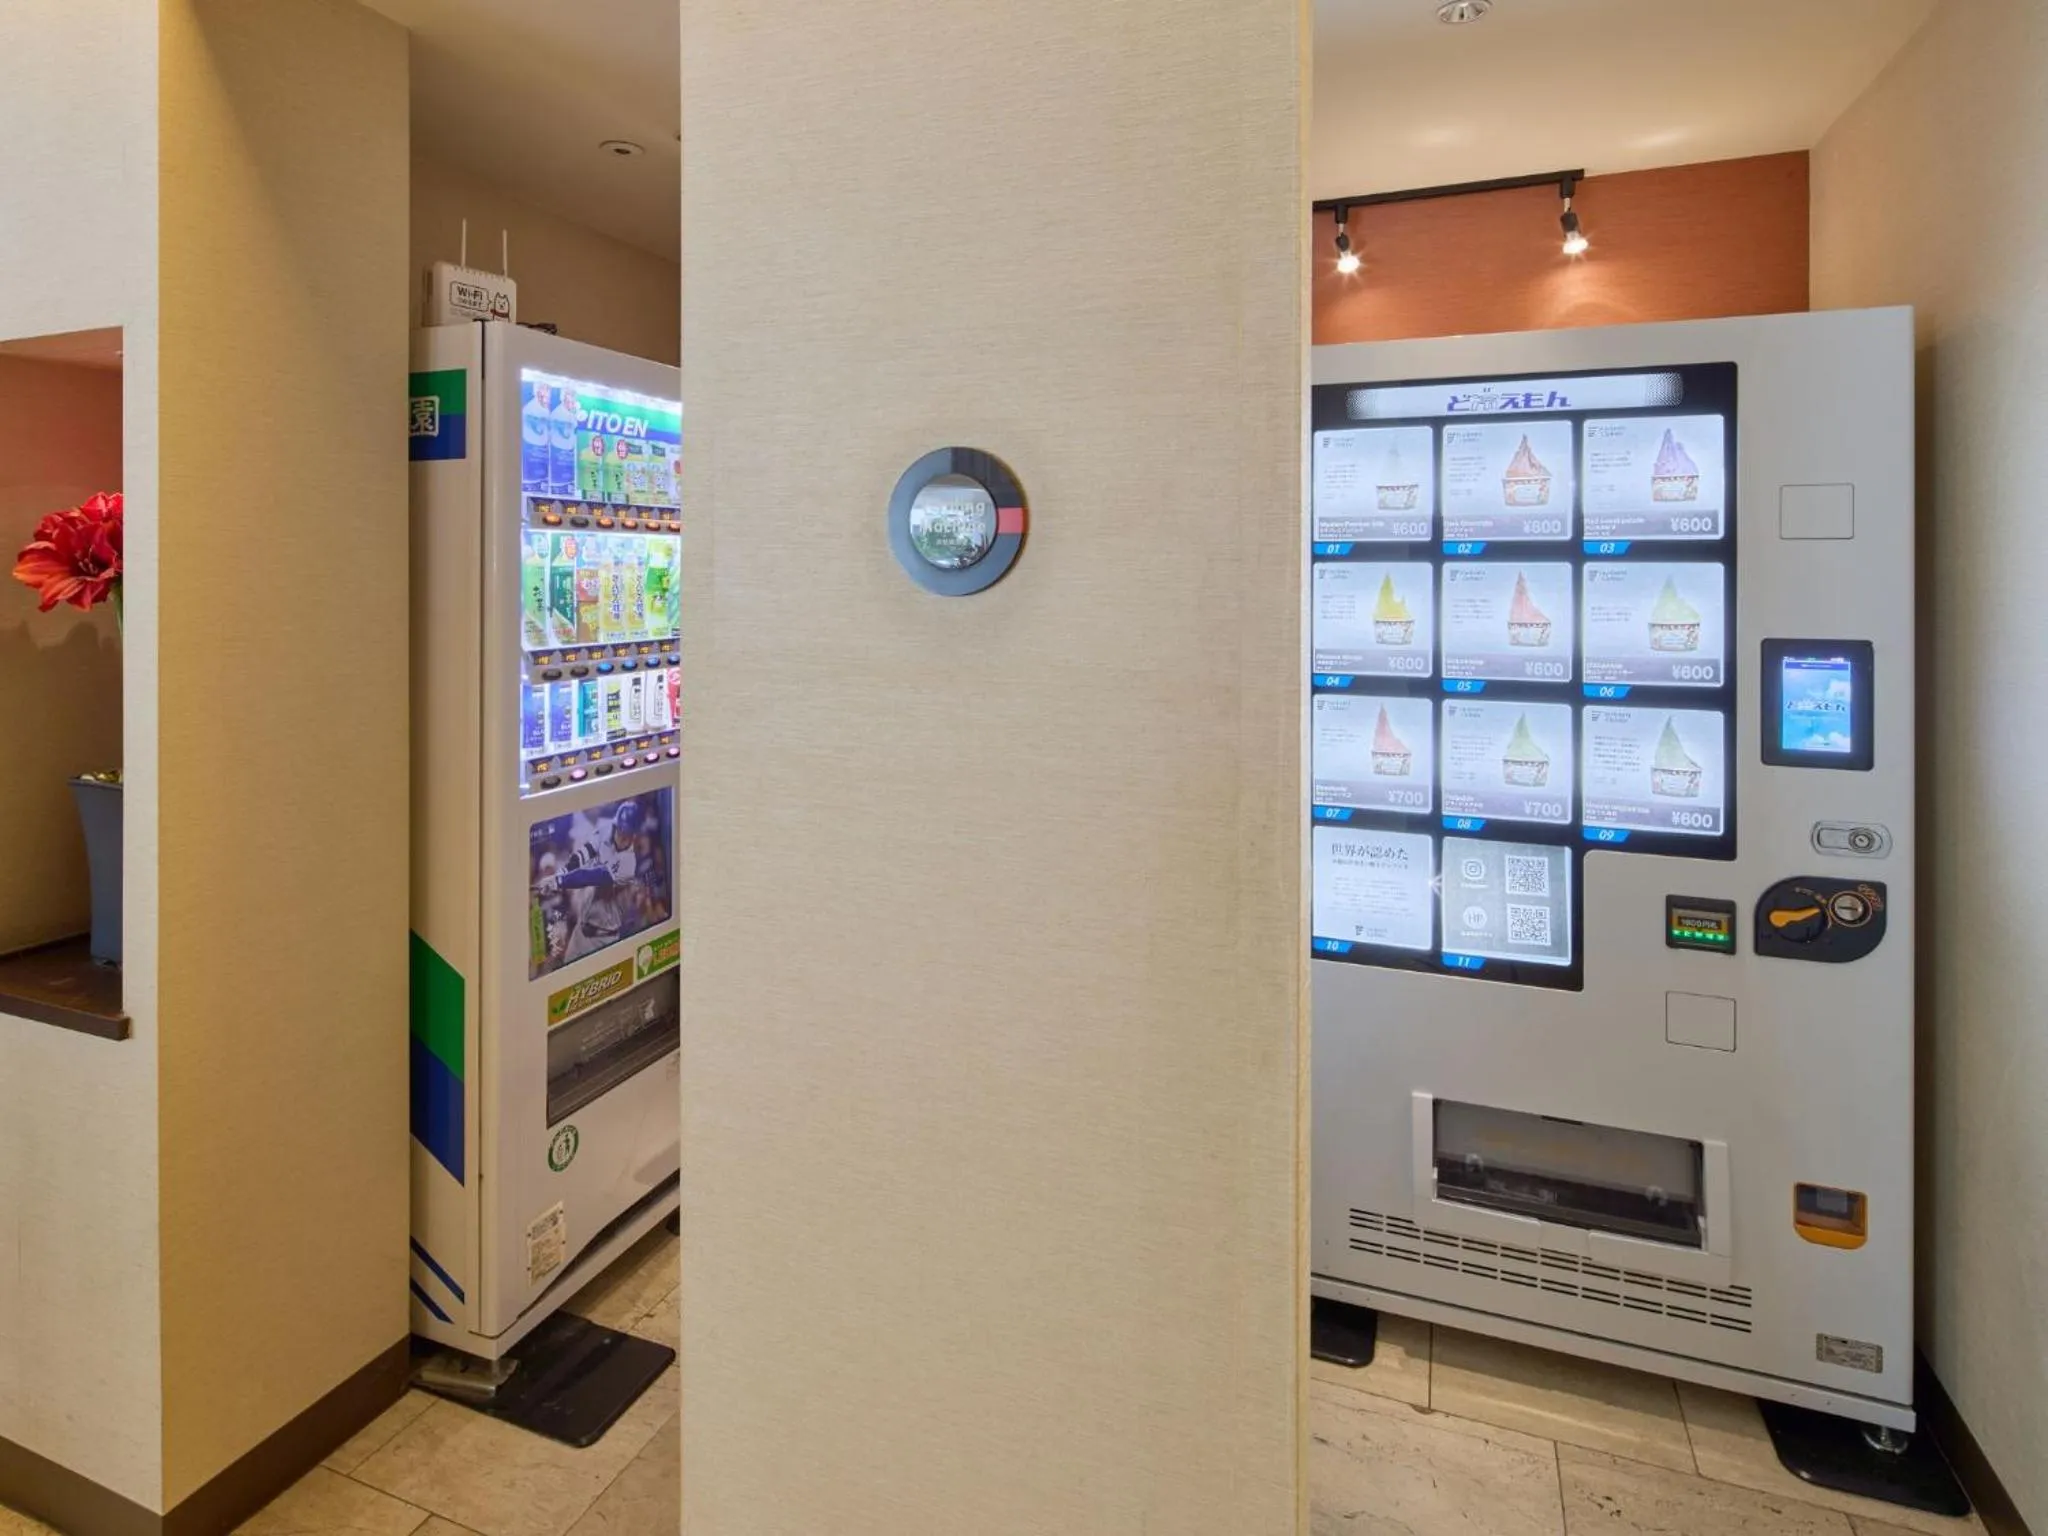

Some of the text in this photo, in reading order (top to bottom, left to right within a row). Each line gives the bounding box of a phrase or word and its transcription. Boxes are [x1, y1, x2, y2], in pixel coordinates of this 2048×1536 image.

[457, 285, 483, 301] Wi-Fi
[587, 410, 649, 438] ITO EN
[1393, 521, 1427, 536] ¥600
[1524, 520, 1562, 534] ¥600
[1670, 517, 1712, 532] ¥600
[1327, 543, 1341, 554] 01
[1457, 543, 1472, 554] 02
[1600, 543, 1615, 553] 03
[1388, 656, 1424, 670] ¥600
[1525, 662, 1564, 676] ¥600
[1672, 665, 1714, 680] ¥600
[1326, 676, 1340, 686] 04
[1457, 681, 1472, 691] 05
[1600, 686, 1615, 697] 06
[1388, 790, 1424, 805] ¥700
[1326, 808, 1340, 818] 07
[1524, 801, 1562, 817] ¥700
[1672, 811, 1713, 828] ¥600
[1599, 830, 1615, 841] 09
[1327, 941, 1339, 952] 10
[1458, 957, 1470, 968] 11
[567, 970, 623, 1010] HYBRID
